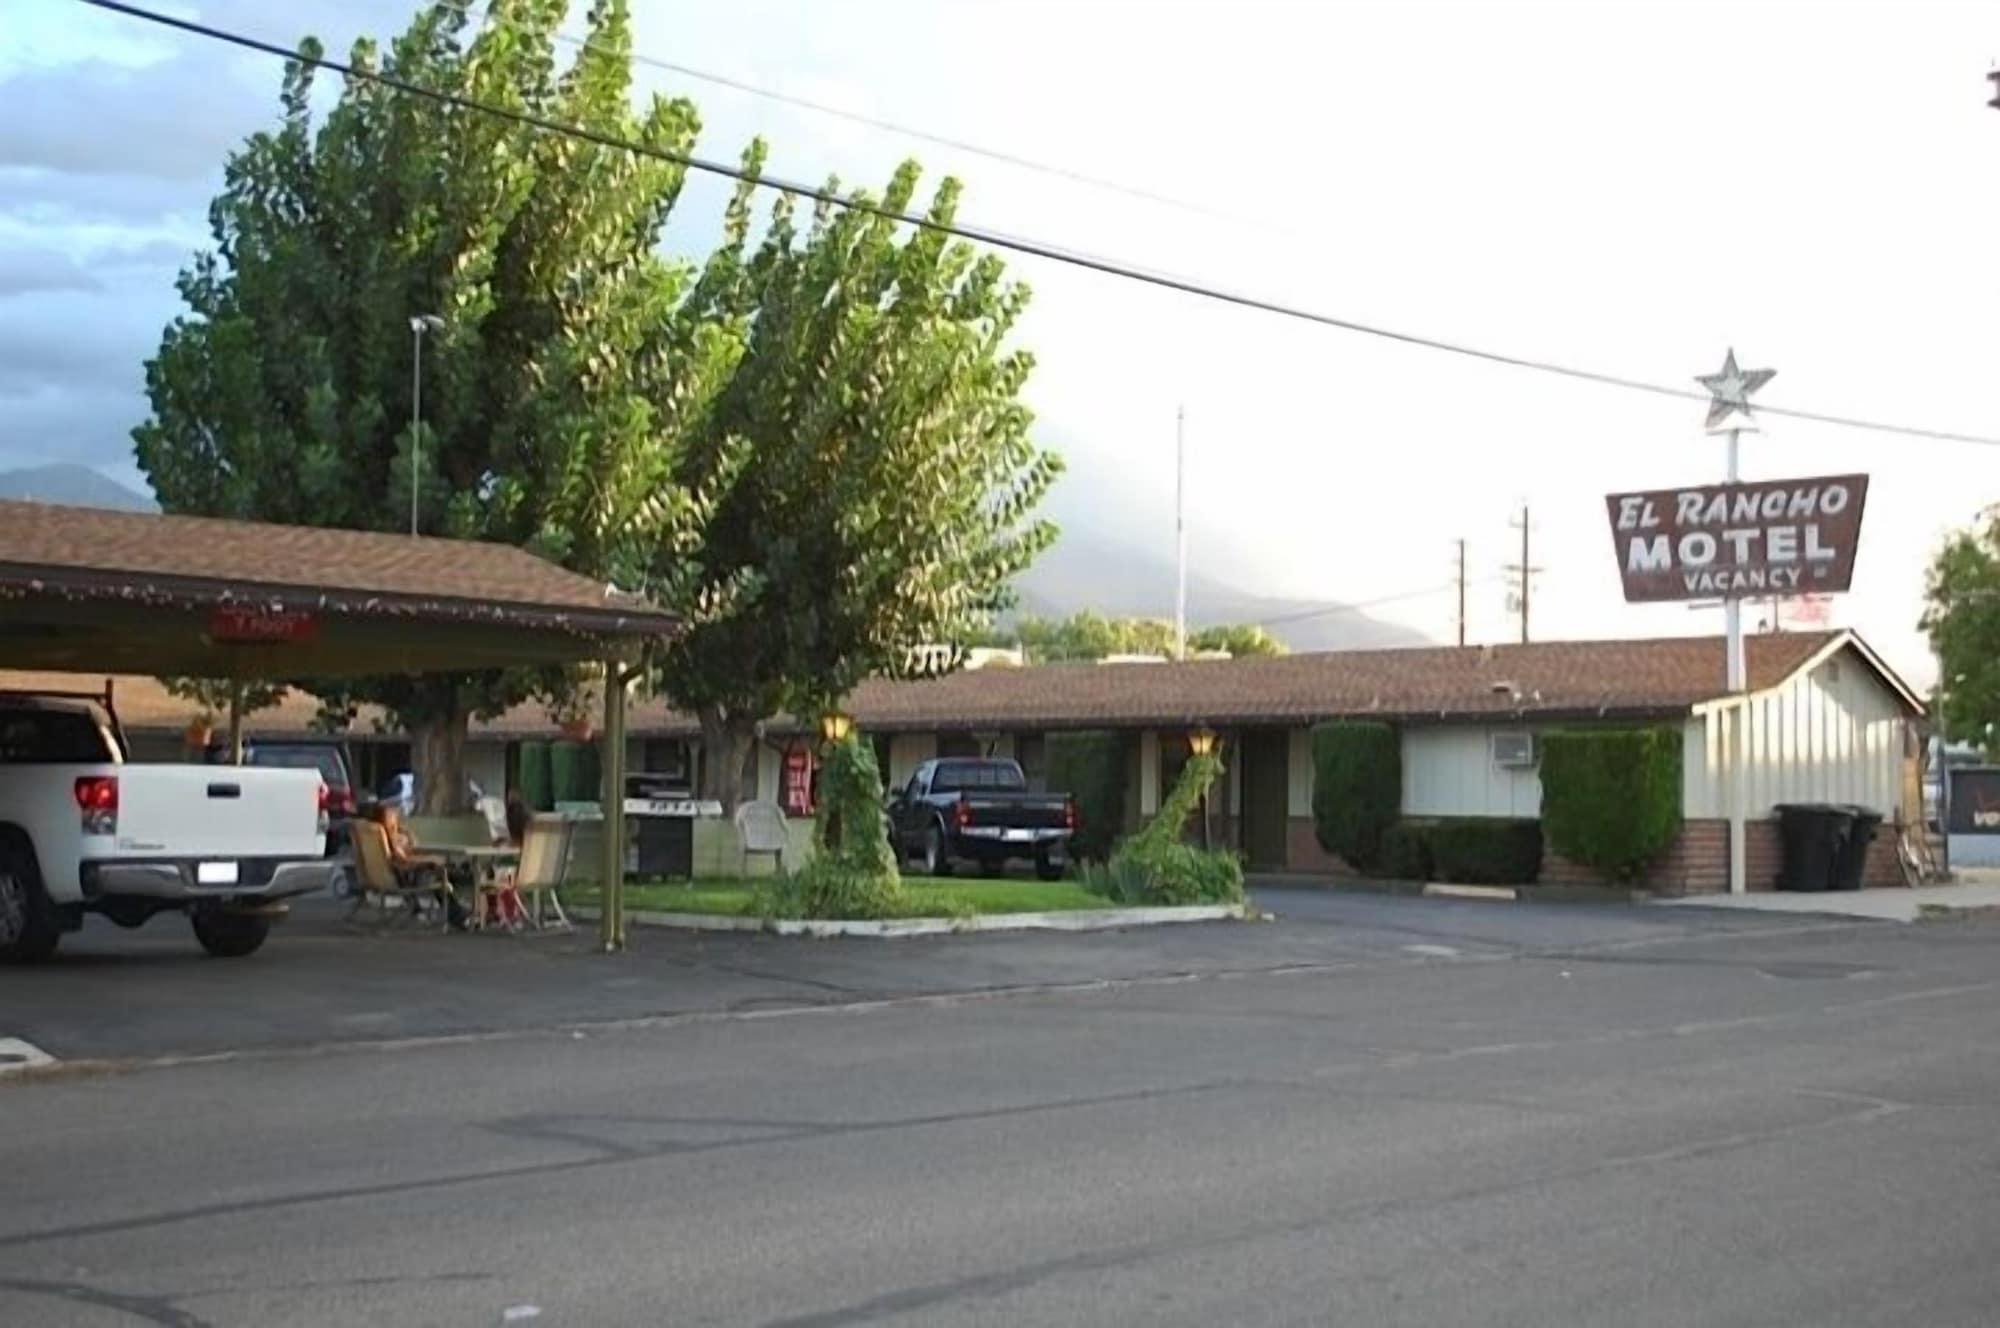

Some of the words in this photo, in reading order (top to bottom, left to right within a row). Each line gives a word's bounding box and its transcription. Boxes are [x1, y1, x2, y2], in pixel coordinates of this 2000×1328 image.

[1618, 497, 1660, 530] EL
[1675, 484, 1849, 525] RANCHO
[1627, 523, 1836, 572] MOTEL
[1684, 567, 1801, 591] VACANCY
